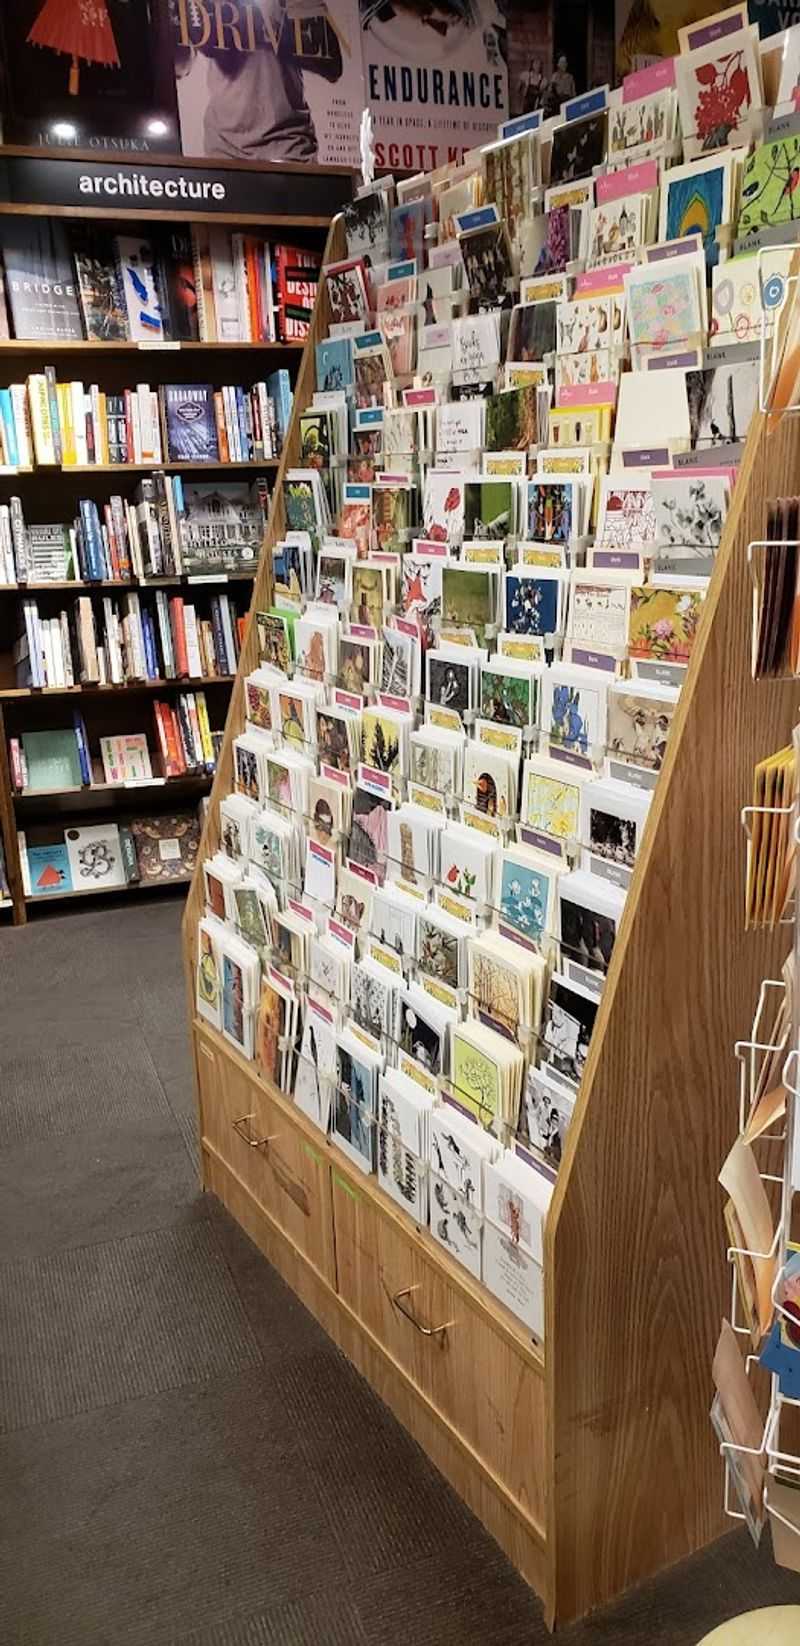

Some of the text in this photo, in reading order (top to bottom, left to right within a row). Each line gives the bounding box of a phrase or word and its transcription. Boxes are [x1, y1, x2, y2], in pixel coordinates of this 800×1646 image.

[368, 64, 505, 110] ENDURANCE
[89, 136, 150, 152] OTSUKA
[374, 143, 438, 169] SCOTT
[79, 172, 226, 201] architecture
[11, 280, 74, 297] BRIDGE
